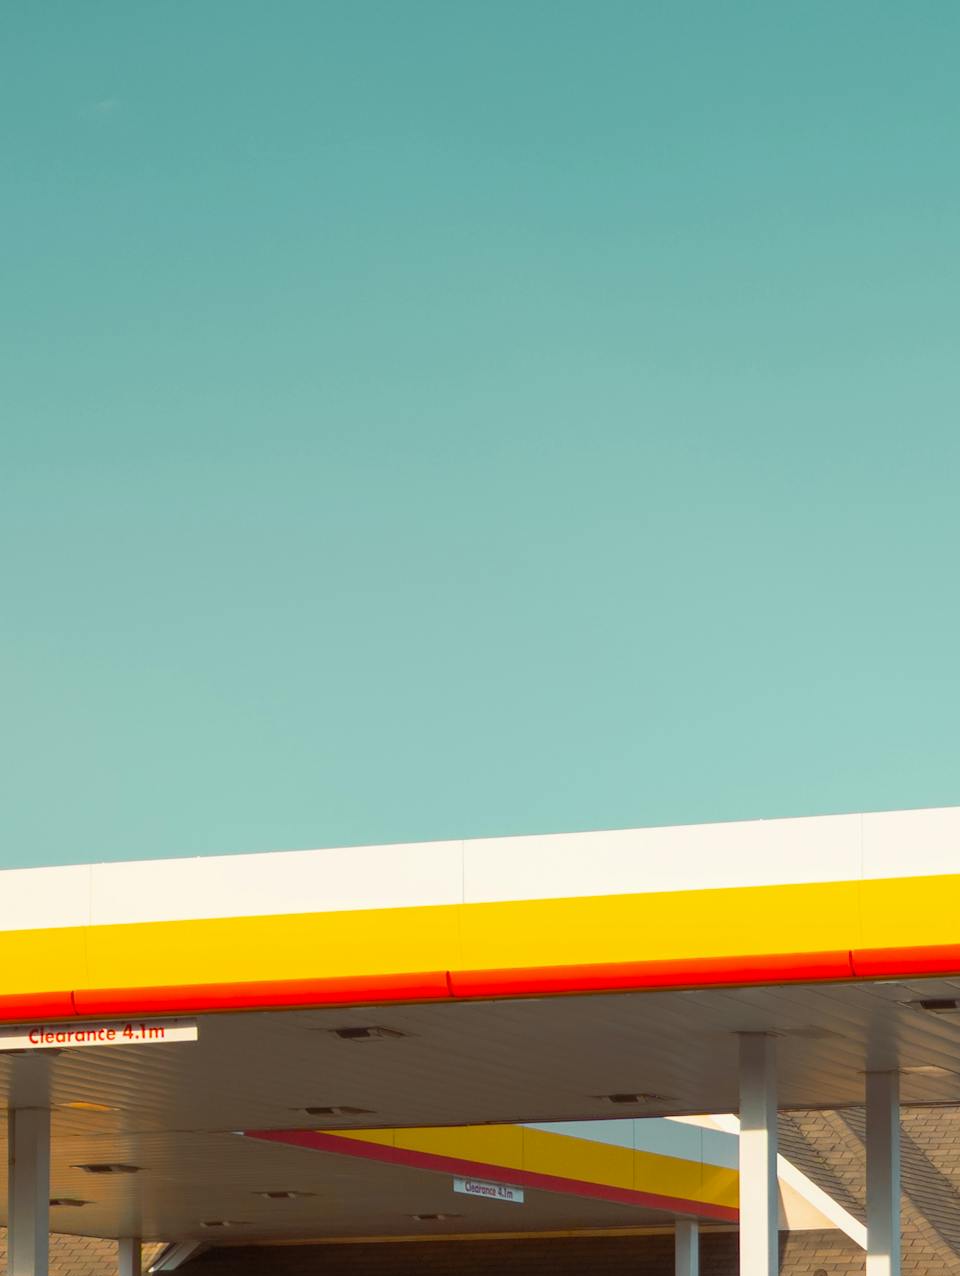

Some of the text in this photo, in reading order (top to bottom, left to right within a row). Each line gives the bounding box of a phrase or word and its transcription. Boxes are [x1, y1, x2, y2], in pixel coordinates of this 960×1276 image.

[28, 1023, 165, 1044] Clearance 4.1m
[464, 1181, 513, 1199] Clearance 4.1m
